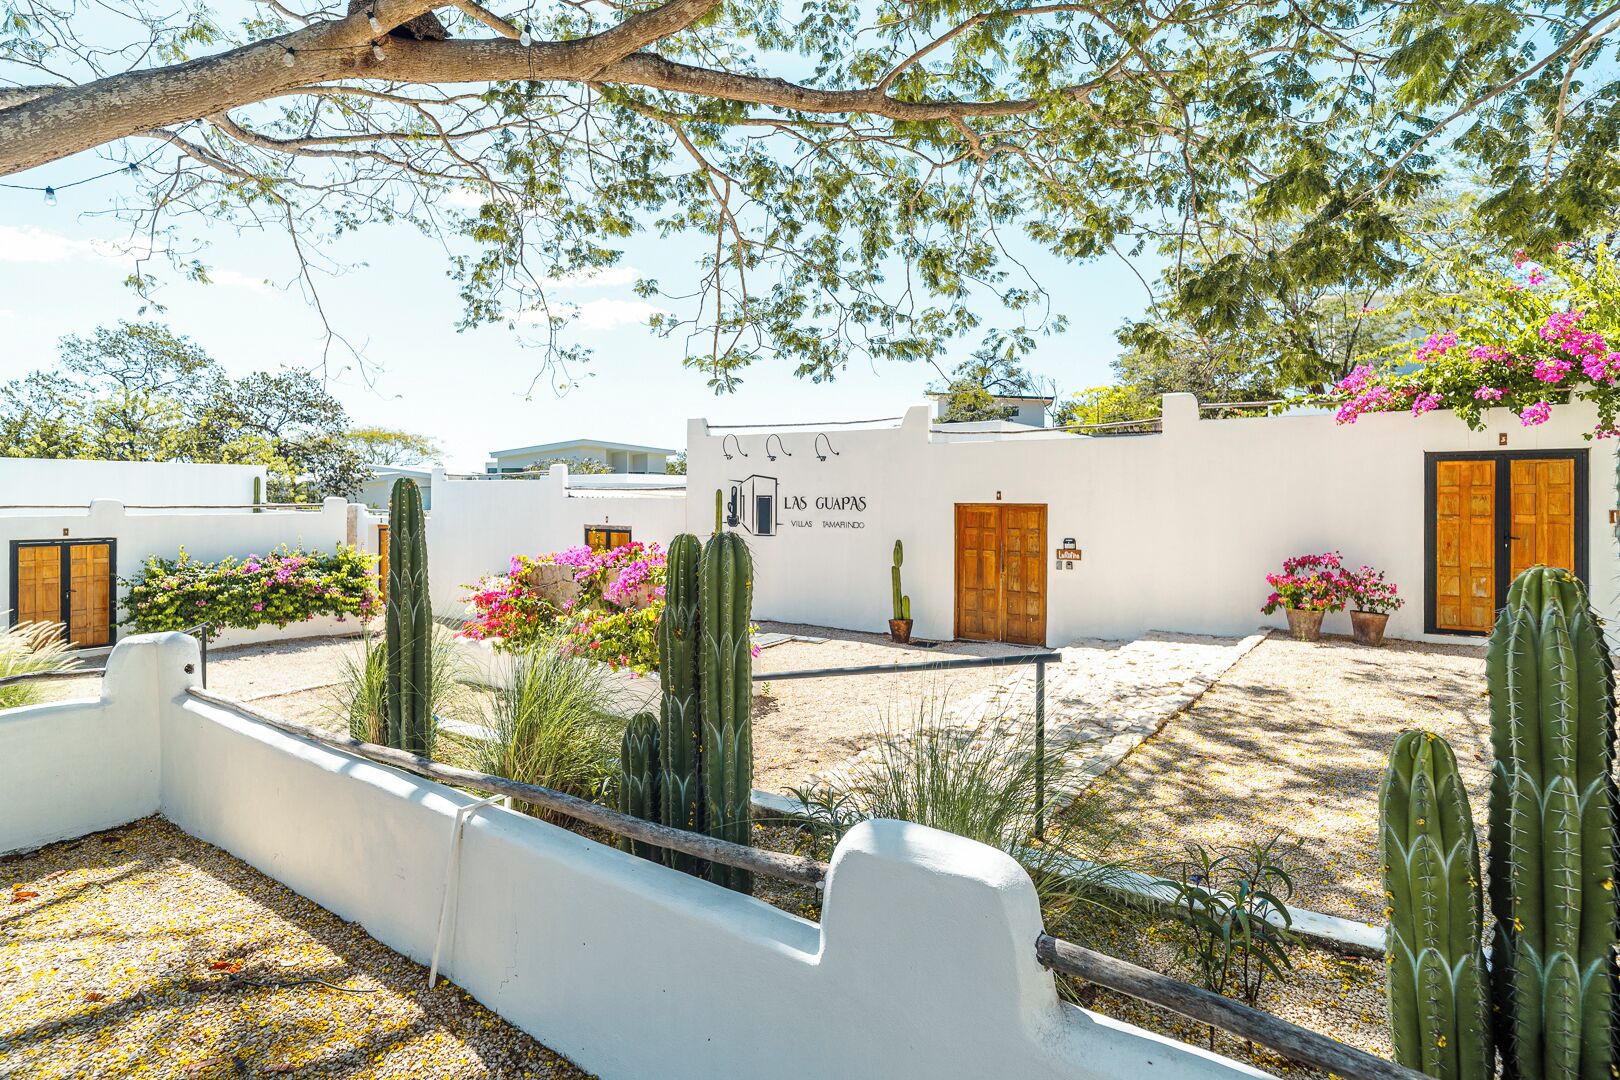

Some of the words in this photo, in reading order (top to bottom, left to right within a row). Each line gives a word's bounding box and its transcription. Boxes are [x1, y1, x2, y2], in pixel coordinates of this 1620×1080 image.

[784, 496, 808, 510] LAS
[815, 496, 867, 512] GUAPAS
[791, 520, 812, 528] VILLAS
[822, 521, 865, 529] TAMARINDO
